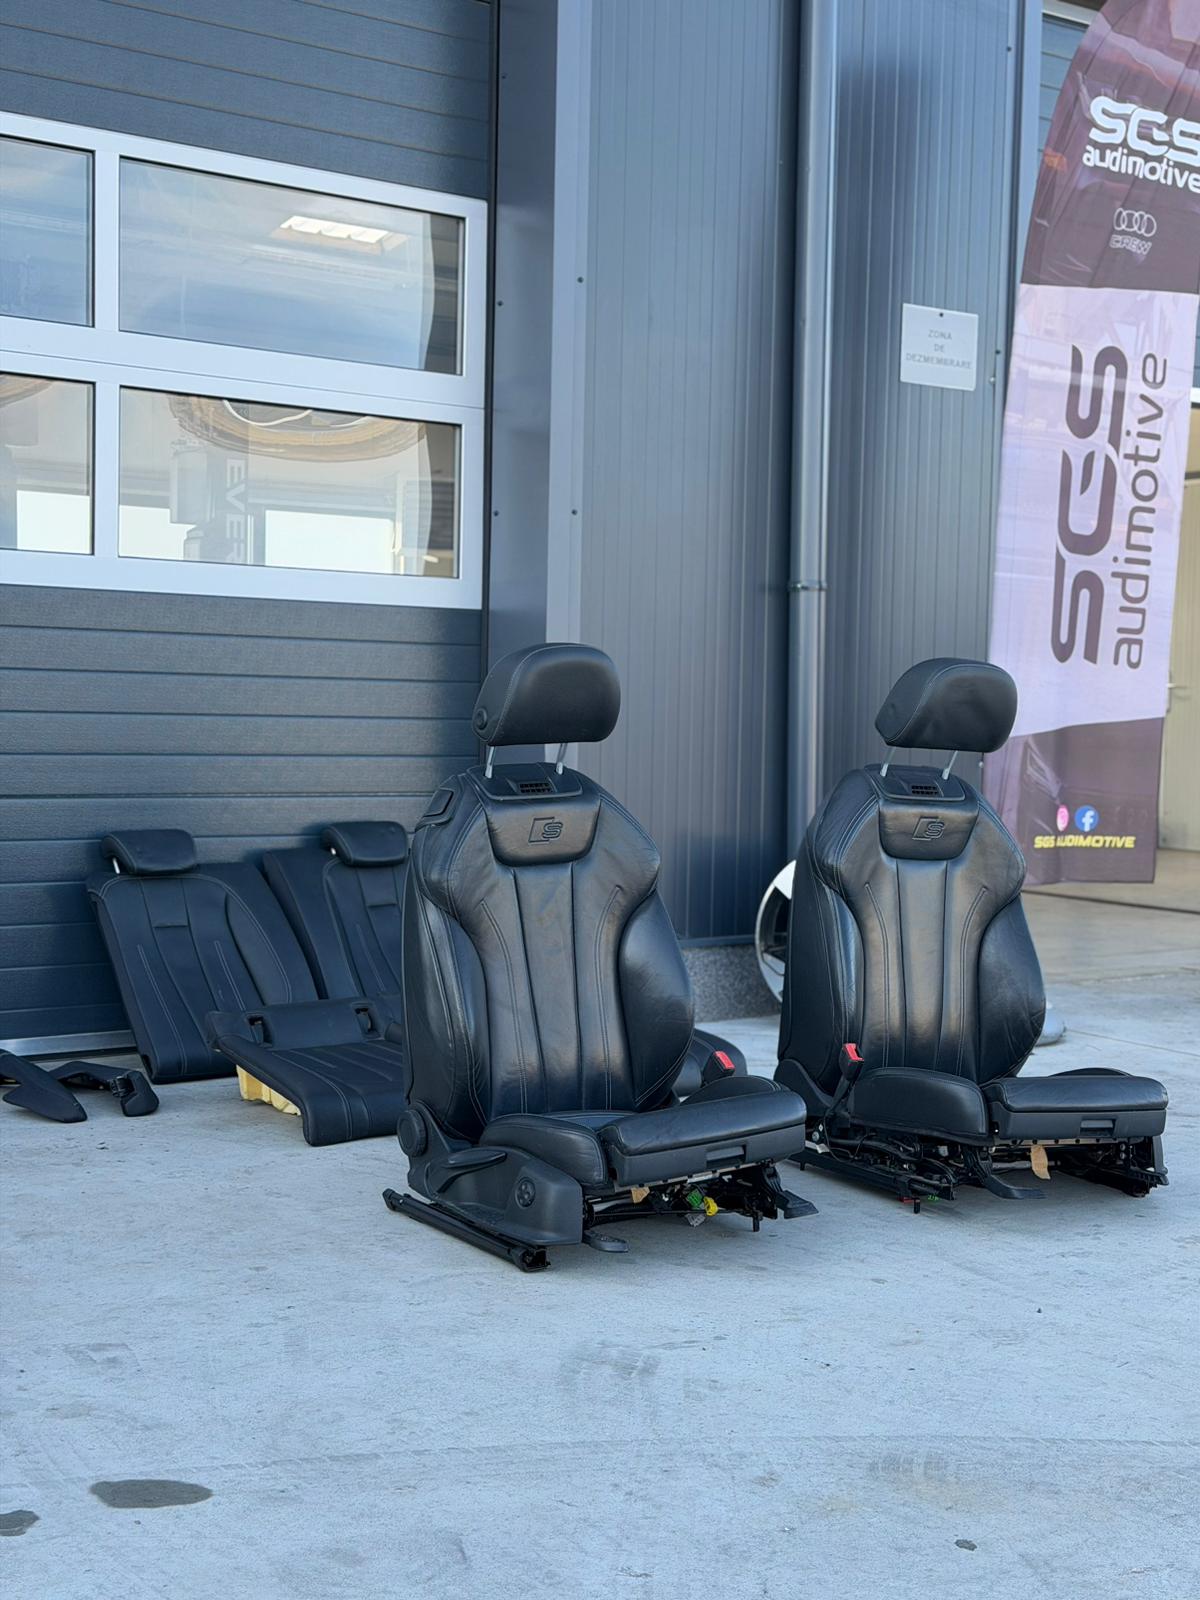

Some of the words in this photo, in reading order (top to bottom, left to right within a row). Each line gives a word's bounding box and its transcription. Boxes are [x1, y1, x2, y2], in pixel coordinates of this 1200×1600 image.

[1089, 96, 1200, 167] SGS
[1082, 144, 1200, 194] audimotive
[928, 329, 953, 340] ZONA
[934, 343, 946, 353] DE
[1051, 344, 1128, 665] SGS
[1111, 352, 1168, 670] audimotive
